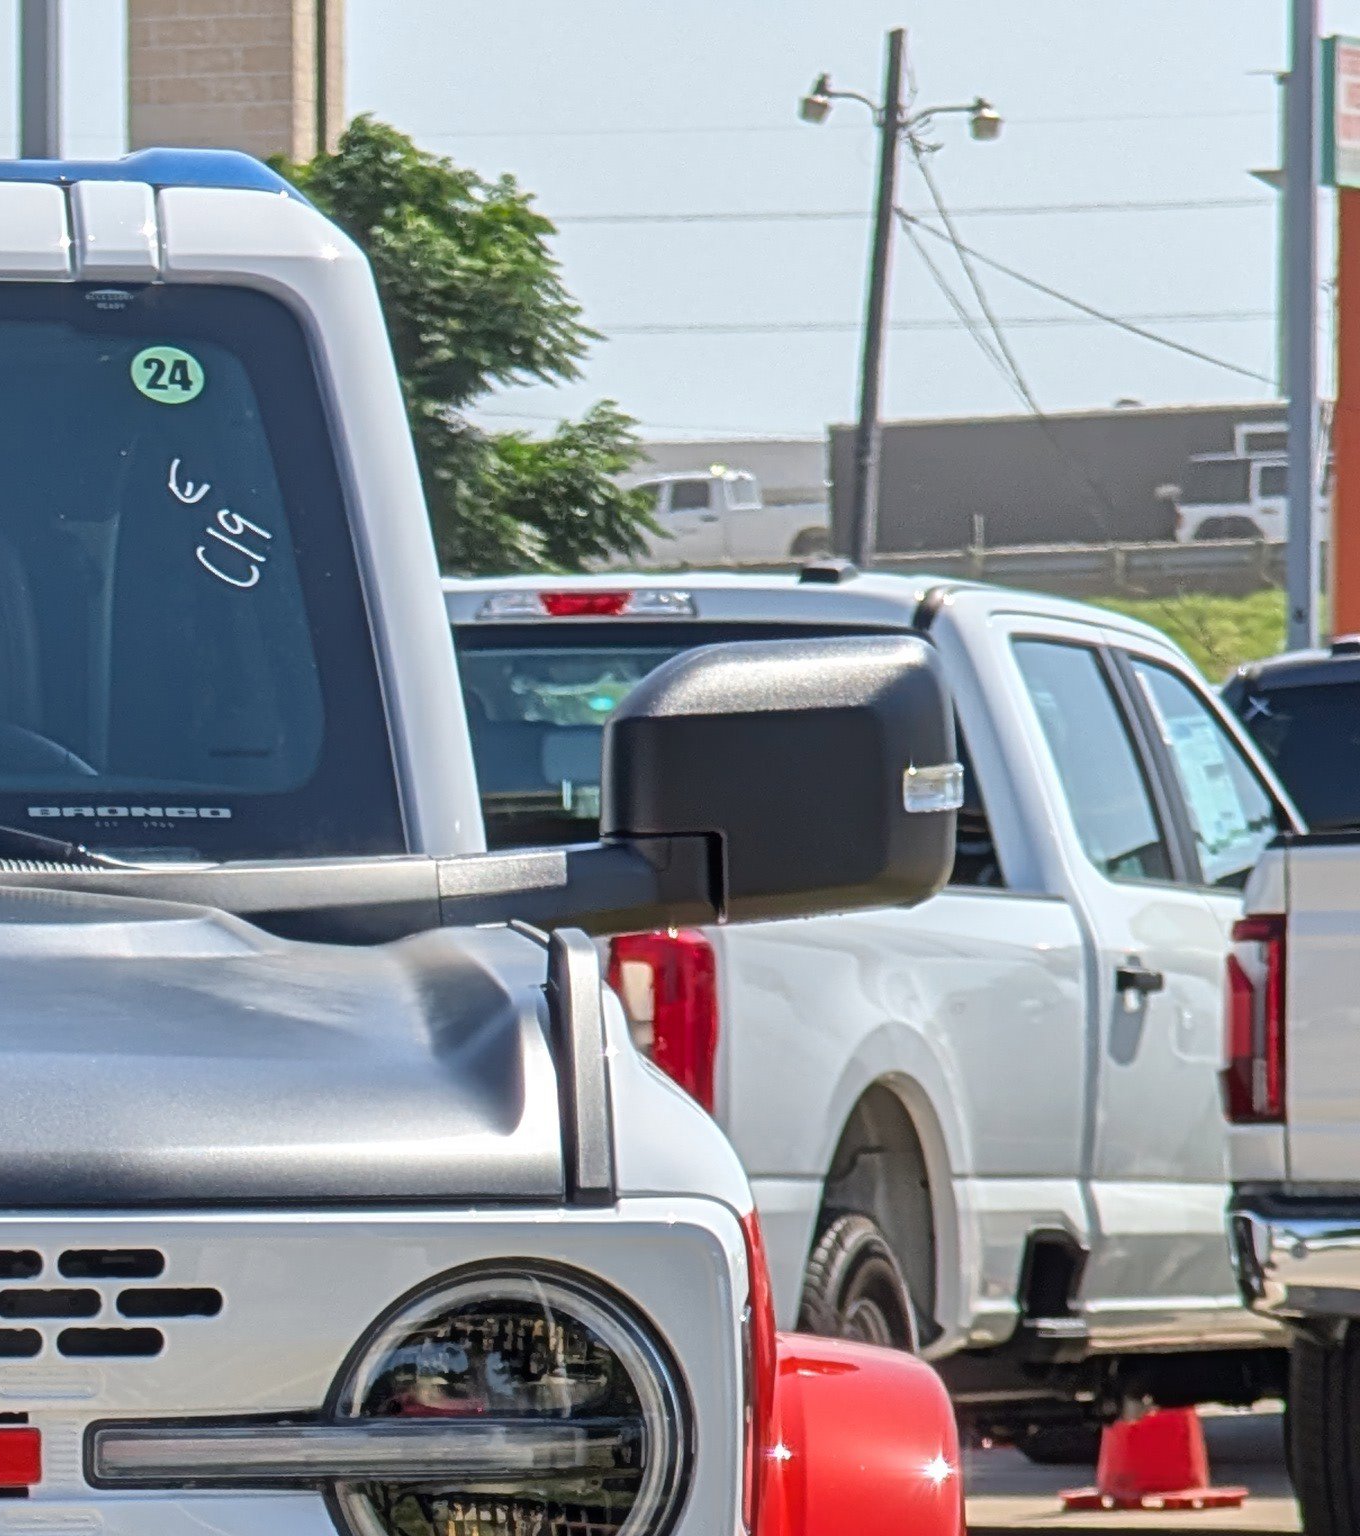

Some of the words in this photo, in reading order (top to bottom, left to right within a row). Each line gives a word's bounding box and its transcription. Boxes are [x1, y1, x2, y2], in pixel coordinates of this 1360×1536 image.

[143, 357, 193, 391] 24
[195, 507, 274, 589] C19
[27, 806, 232, 818] BRONCO
